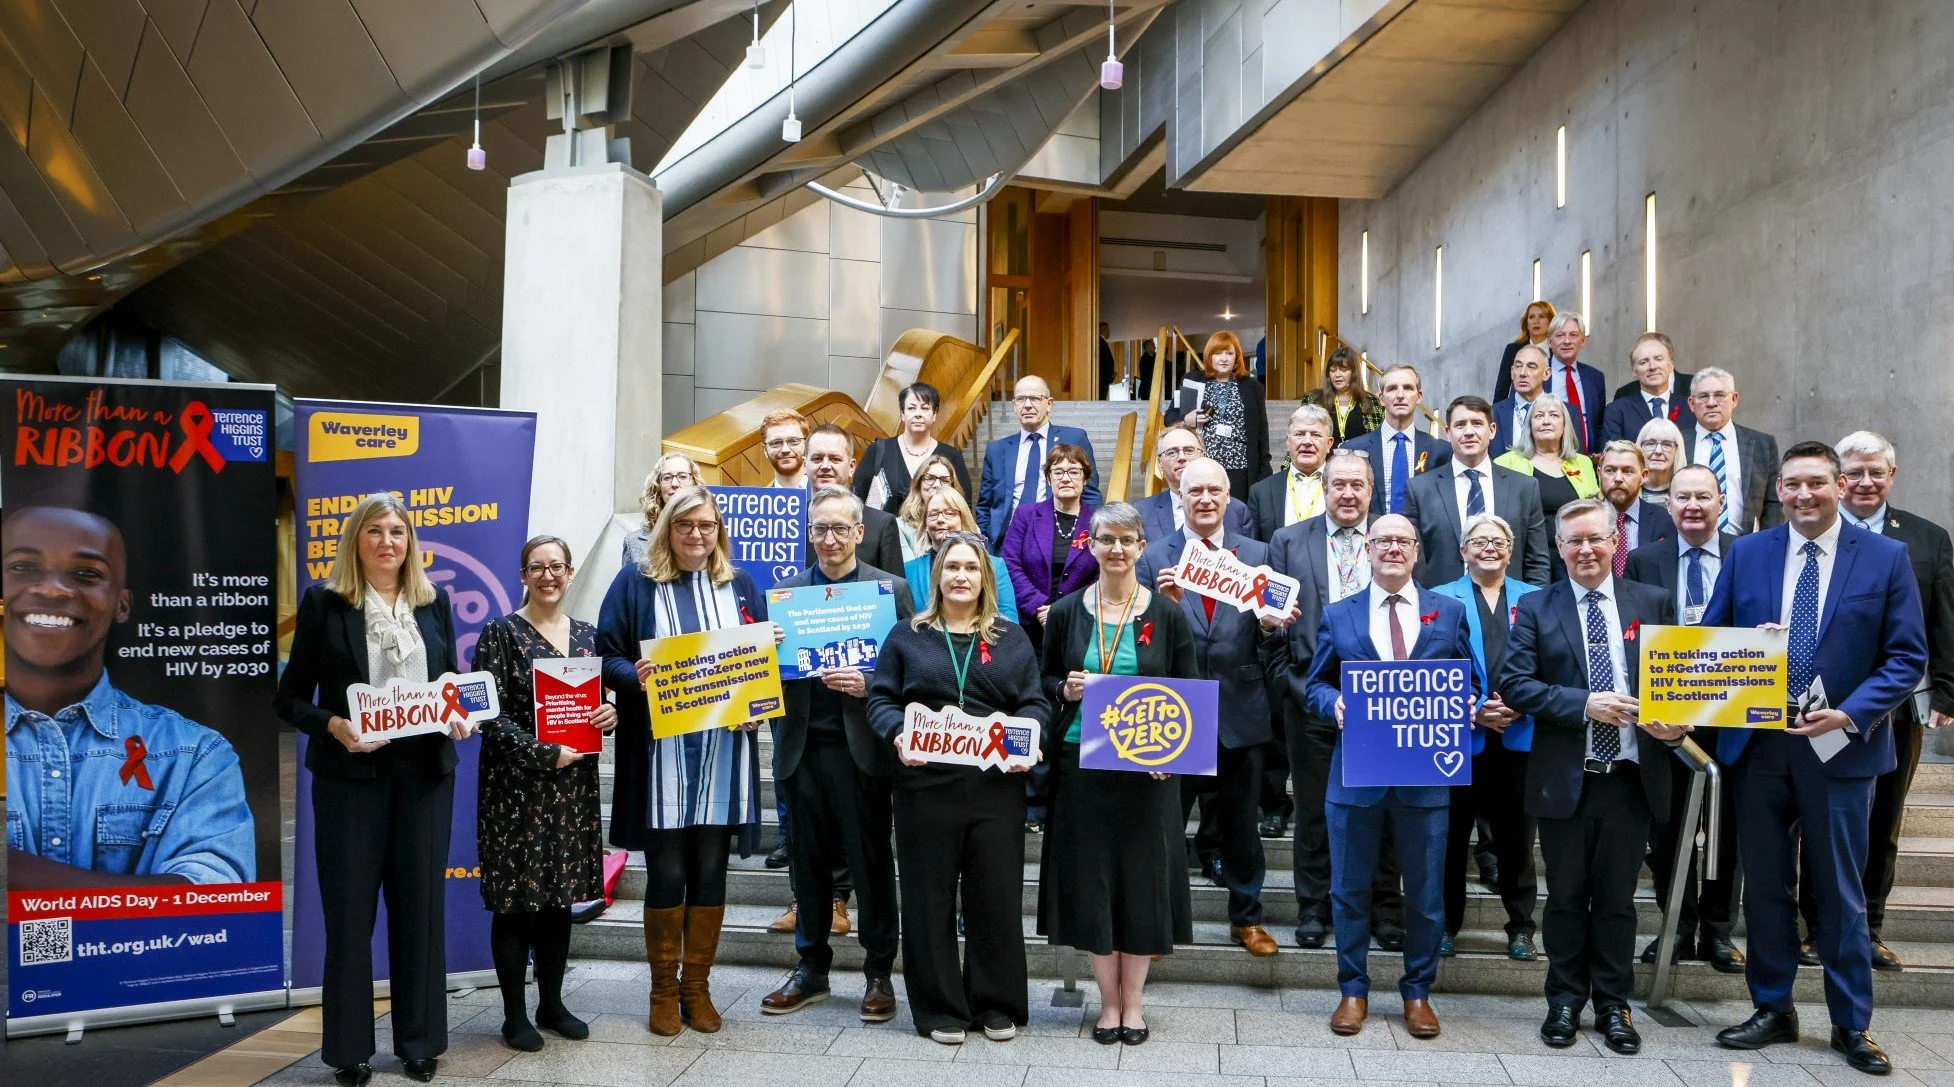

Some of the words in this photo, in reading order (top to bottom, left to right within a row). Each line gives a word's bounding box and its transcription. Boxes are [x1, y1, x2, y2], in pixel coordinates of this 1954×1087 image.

[16, 388, 81, 424] More
[86, 386, 149, 424] than
[152, 410, 174, 426] a
[321, 421, 408, 440] Waverley
[15, 426, 171, 470] RIBBON
[355, 438, 397, 448] care
[410, 486, 454, 507] HIV
[1188, 546, 1215, 567] More
[192, 573, 219, 587] It's
[223, 577, 269, 587] more
[1181, 563, 1247, 599] RIBBON
[151, 593, 192, 607] than
[196, 597, 208, 606] a
[211, 592, 269, 606] ribbon
[787, 610, 802, 618] The
[803, 607, 845, 616] Parliament
[138, 623, 165, 637] It's
[168, 627, 180, 636] a
[183, 622, 247, 640] pledge
[251, 622, 269, 635] to
[807, 625, 841, 634] Scotland
[118, 643, 154, 657] end
[157, 646, 196, 656] new
[200, 644, 249, 655] cases
[252, 641, 271, 654] of
[674, 654, 716, 670] taking
[718, 644, 757, 661] action
[1649, 651, 1670, 660] I'm
[1673, 649, 1718, 661] taking
[1720, 648, 1765, 659] action
[165, 662, 199, 676] HIV
[201, 662, 223, 678] by
[226, 662, 270, 676] 2030
[655, 678, 669, 688] to
[671, 660, 743, 685] #GetToZero
[744, 655, 769, 668] new
[1649, 665, 1663, 674] to
[1666, 663, 1746, 674] #GetToZero
[1749, 664, 1777, 672] new
[657, 688, 680, 701] HIV
[682, 669, 769, 696] transmissions
[1651, 678, 1674, 687] HIV
[1677, 676, 1775, 687] transmissions
[357, 692, 391, 711] More
[392, 685, 425, 704] than
[427, 691, 437, 699] a
[660, 703, 673, 714] in
[675, 691, 731, 711] Scotland
[1651, 691, 1664, 701] in
[1666, 691, 1728, 701] Scotland
[360, 702, 438, 733] RIBBON
[1367, 696, 1464, 720] HIGGINS
[913, 711, 943, 729] More
[945, 714, 974, 731] than
[910, 731, 983, 757] RIBBON
[1391, 723, 1464, 748] TRUST
[21, 896, 76, 912] World
[80, 894, 122, 910] AIDS
[126, 894, 158, 910] Day
[173, 894, 183, 905] 1
[186, 889, 271, 905] December
[77, 929, 228, 957] tht.org.uk/wad
